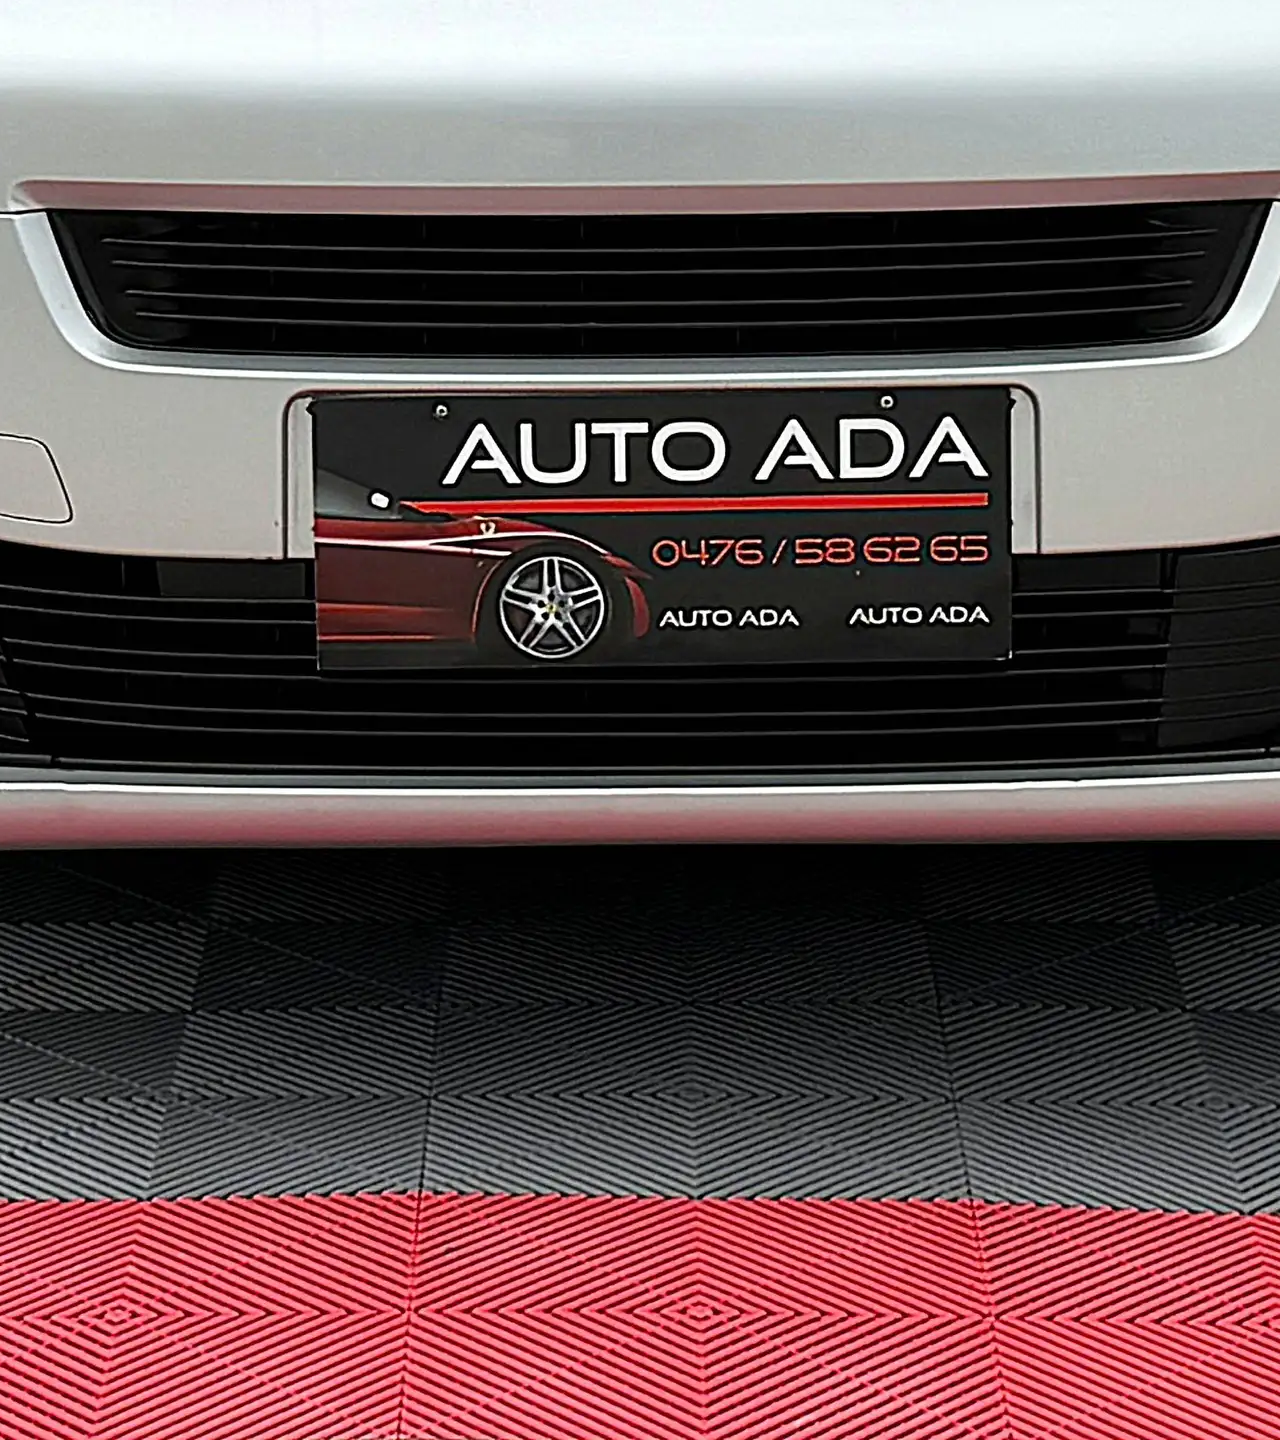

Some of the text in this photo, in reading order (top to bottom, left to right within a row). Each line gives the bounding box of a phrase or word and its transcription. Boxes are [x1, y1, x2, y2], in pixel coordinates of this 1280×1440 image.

[441, 415, 989, 485] AUTO ADA
[651, 539, 764, 567] 0476
[794, 537, 856, 565] 58
[863, 536, 921, 563] 62
[929, 535, 988, 562] 65
[659, 608, 800, 627] AUTO ADA
[849, 605, 990, 625] AUTO ADA
